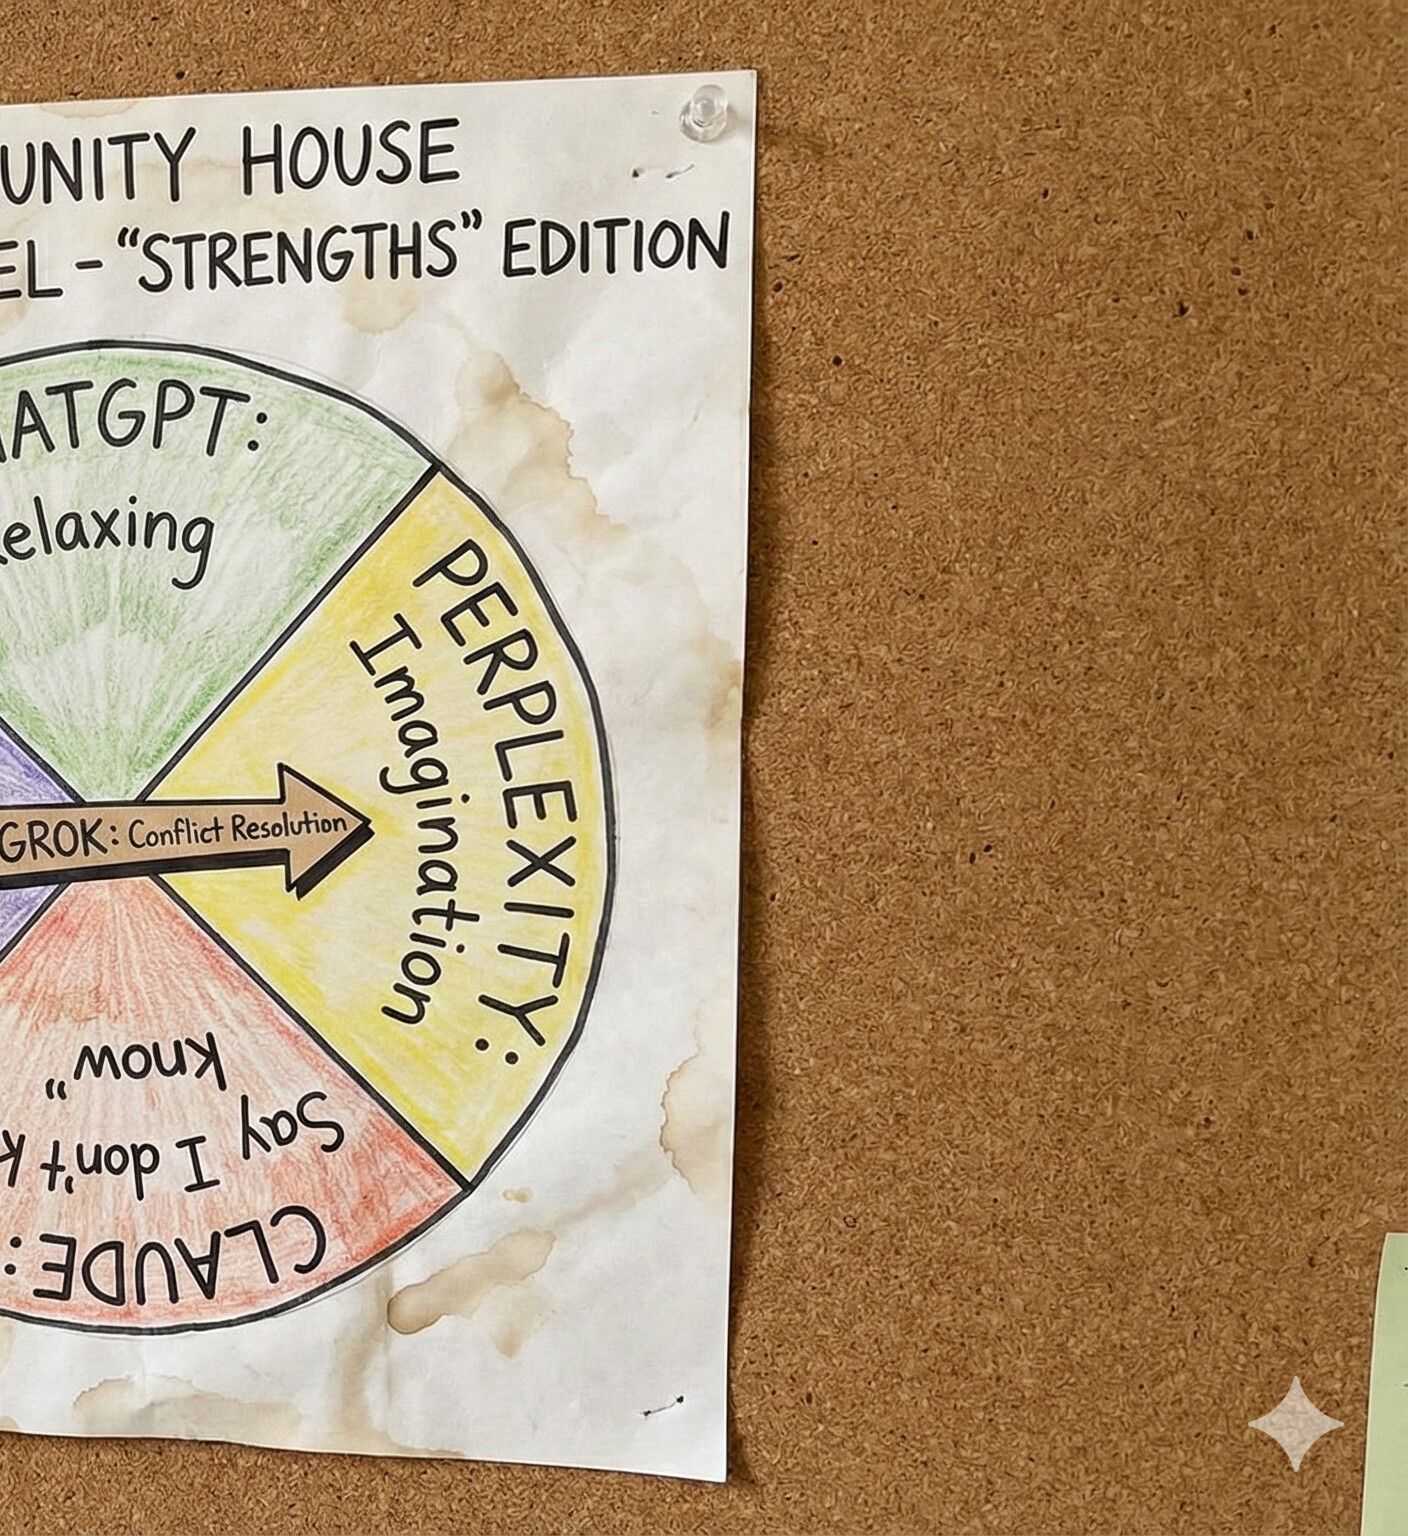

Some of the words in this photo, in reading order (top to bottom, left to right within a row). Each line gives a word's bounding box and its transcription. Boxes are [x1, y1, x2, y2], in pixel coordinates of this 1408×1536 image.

[241, 117, 461, 197] HOUSE
[502, 209, 731, 279] EDITION
[127, 816, 226, 850] Conflict
[230, 808, 349, 843] Resolution
[348, 612, 481, 1026] Imagination
[411, 537, 581, 1066] PERPLEXITY:
[239, 1090, 346, 1162] Say
[39, 1139, 161, 1202] don't
[174, 1134, 222, 1194] I
[3, 1204, 328, 1308] CLAUDE:
